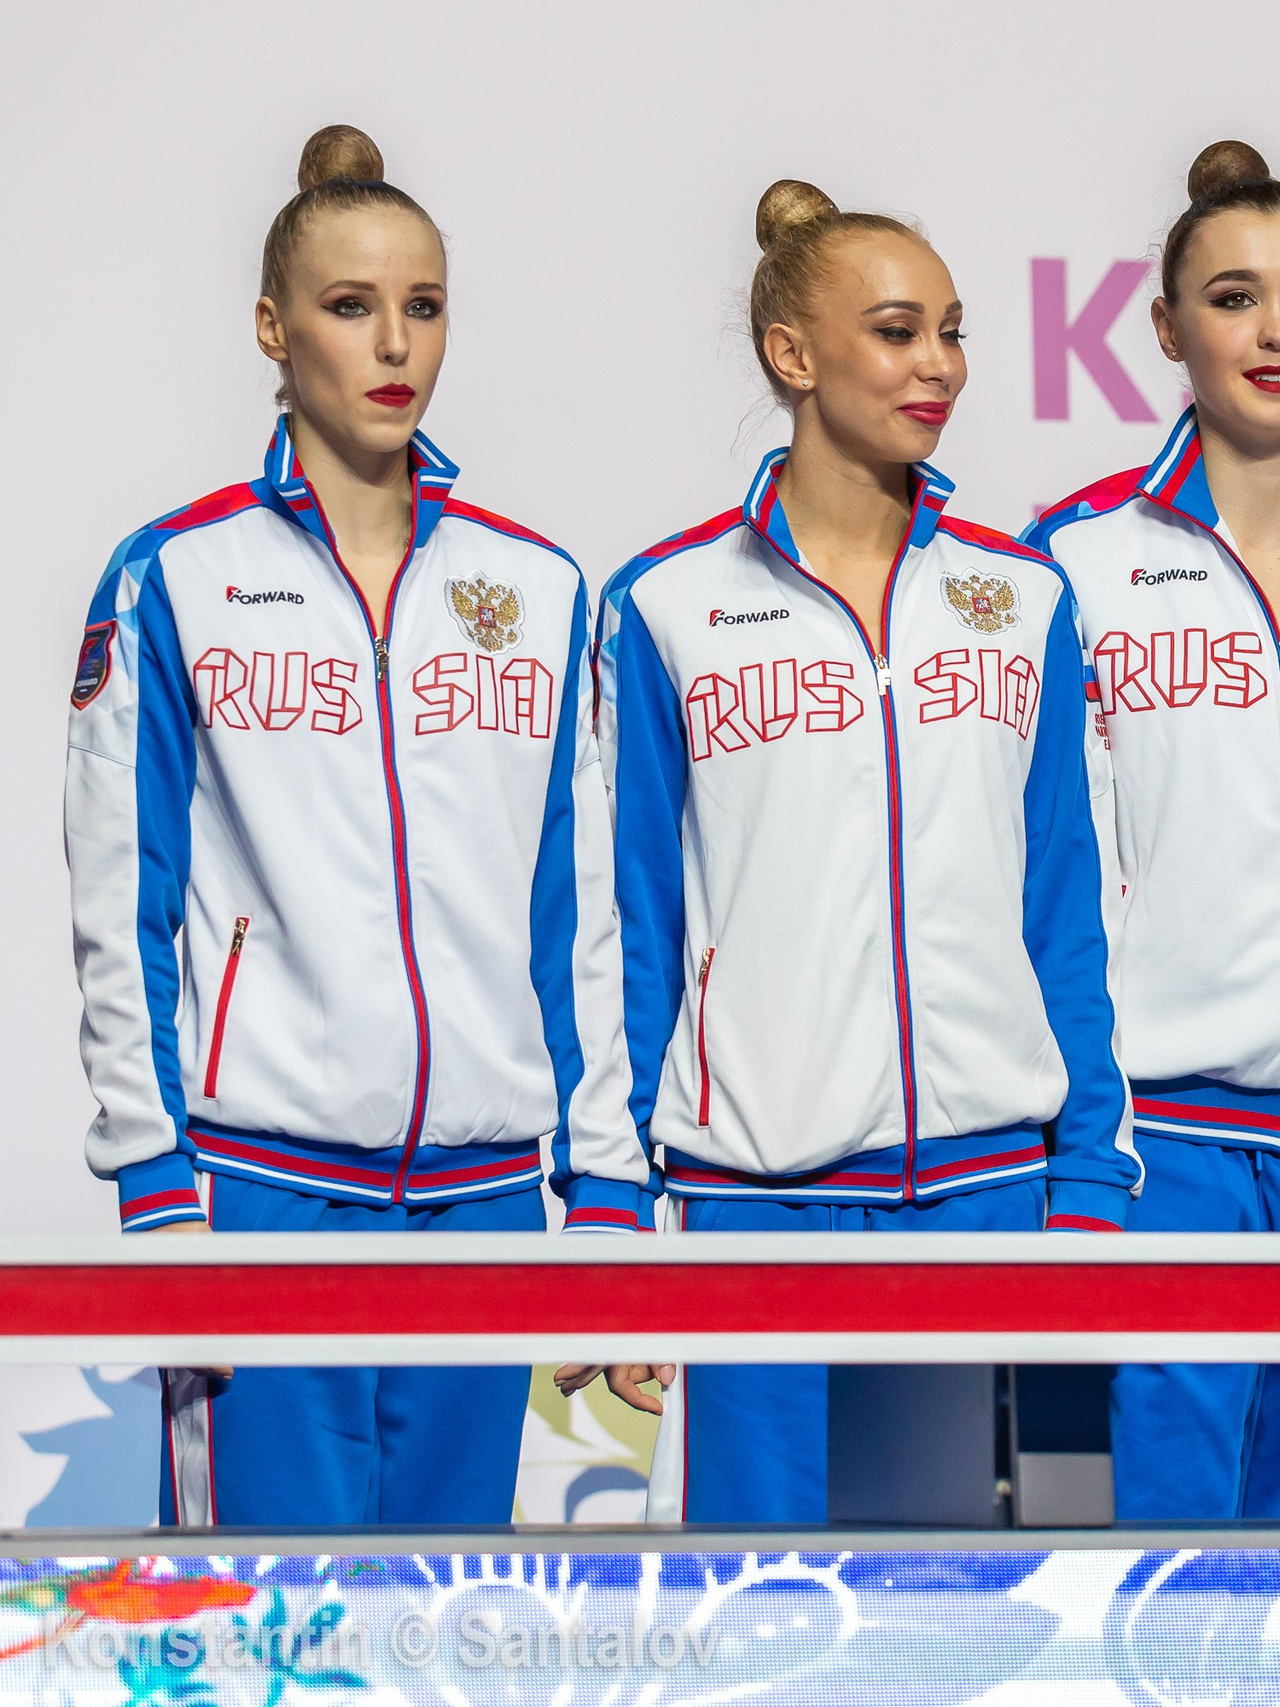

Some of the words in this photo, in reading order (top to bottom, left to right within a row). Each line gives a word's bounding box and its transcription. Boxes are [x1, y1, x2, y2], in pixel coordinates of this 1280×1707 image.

[1130, 568, 1208, 587] FORWARD
[225, 584, 305, 605] FORWARD
[708, 608, 790, 628] FORWARD
